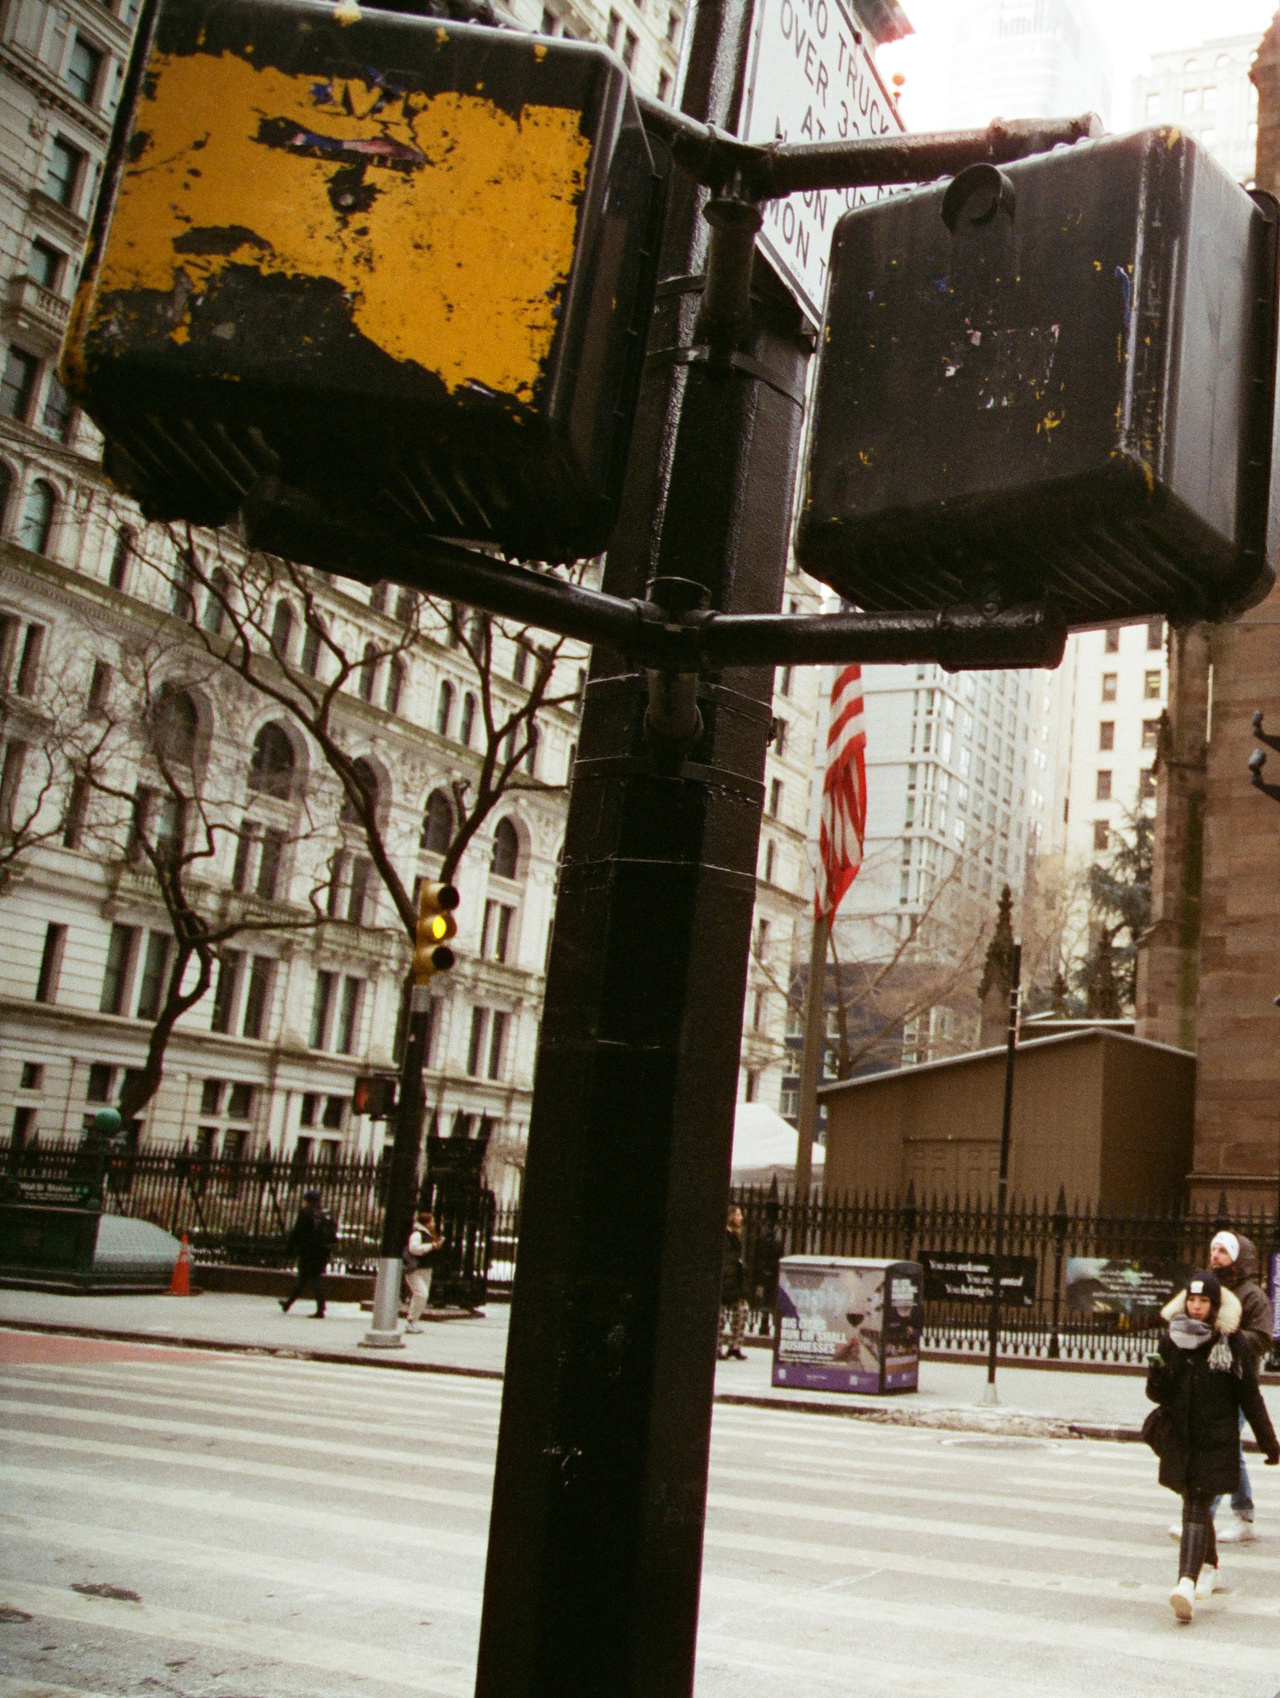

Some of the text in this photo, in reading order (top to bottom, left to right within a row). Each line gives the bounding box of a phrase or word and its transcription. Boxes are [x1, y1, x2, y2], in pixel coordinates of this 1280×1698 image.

[781, 0, 829, 108] OVER
[768, 199, 810, 269] MON
[929, 1259, 944, 1270] You
[1000, 1276, 1024, 1286] anted
